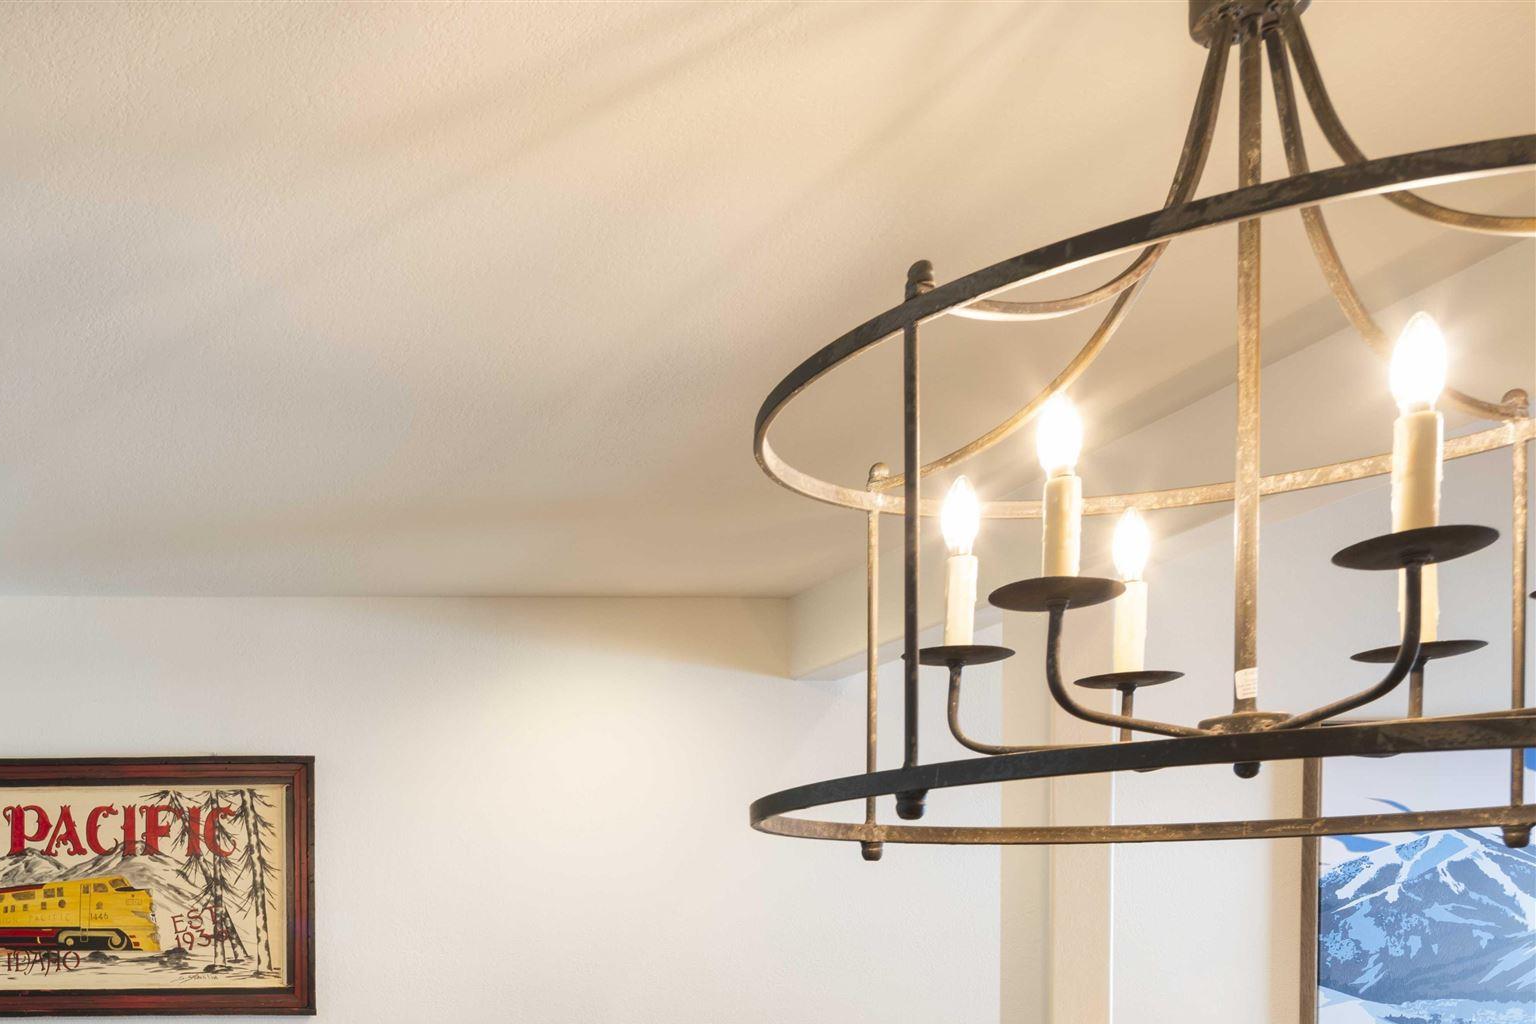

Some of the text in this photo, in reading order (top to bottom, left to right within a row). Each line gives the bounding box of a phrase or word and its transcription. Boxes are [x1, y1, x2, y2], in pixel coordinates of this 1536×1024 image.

[2, 804, 237, 857] PACIFIC
[90, 912, 109, 922] 1446
[7, 949, 80, 976] IDAHO
